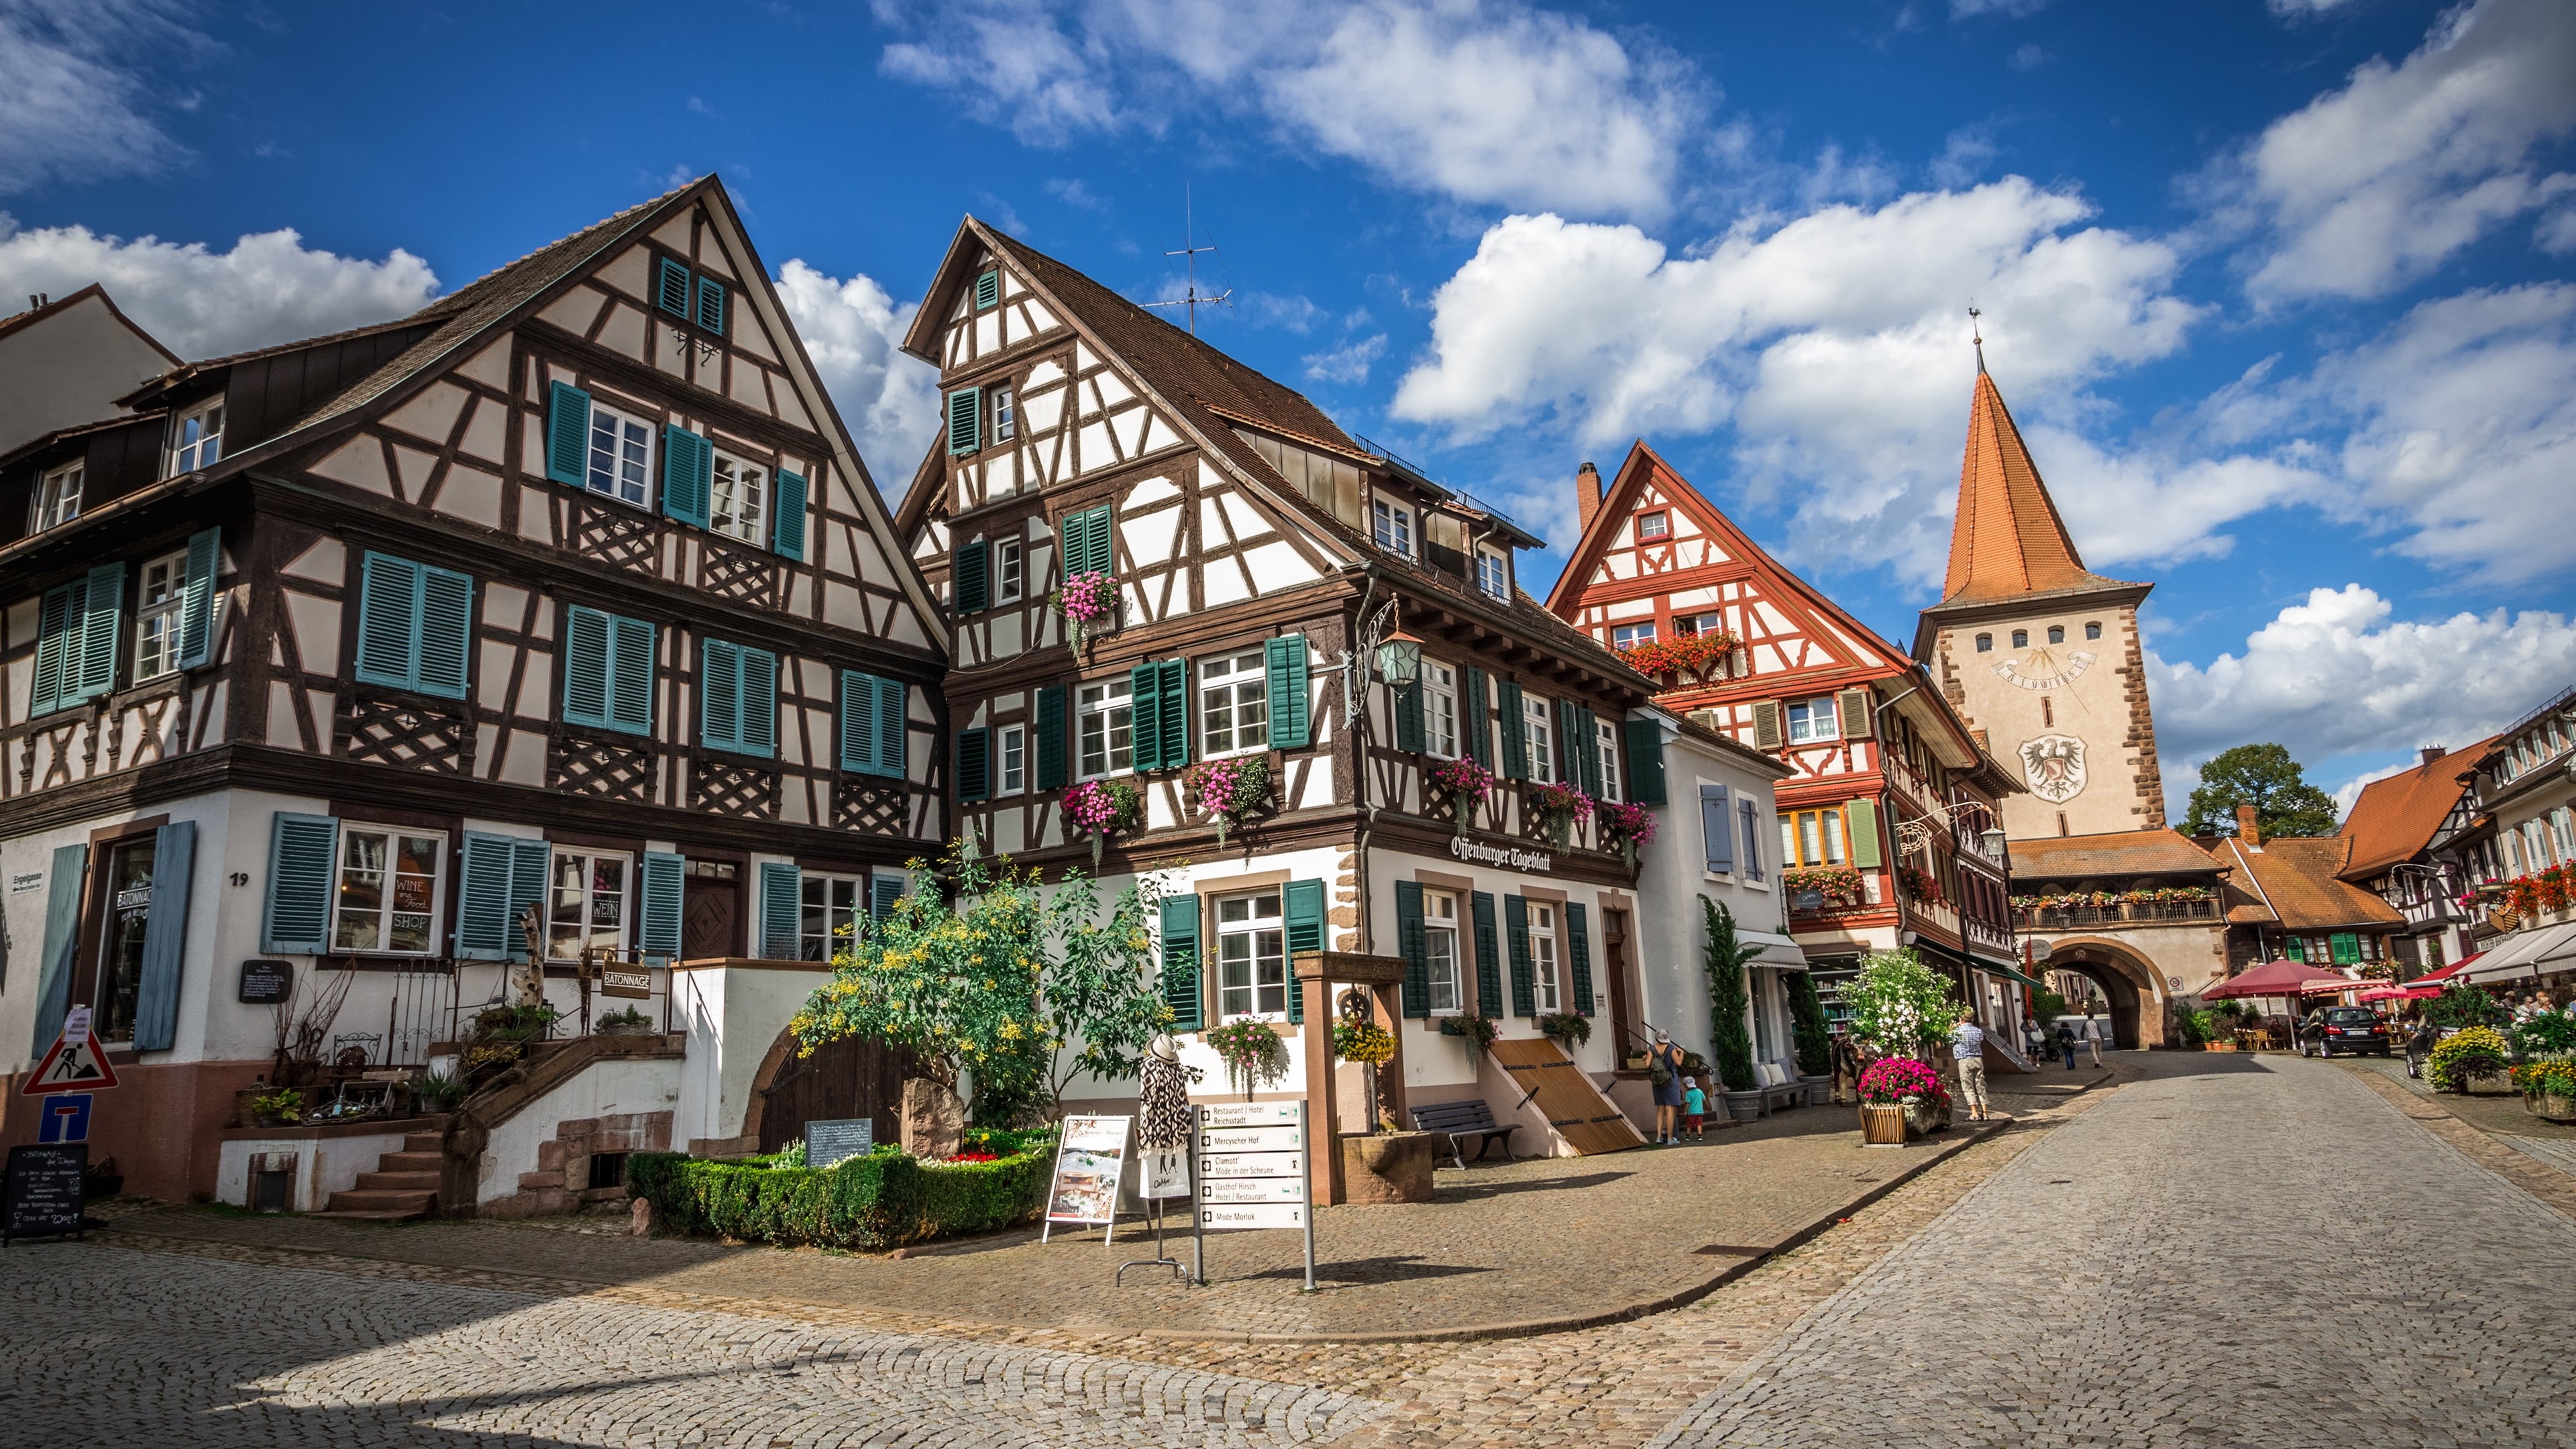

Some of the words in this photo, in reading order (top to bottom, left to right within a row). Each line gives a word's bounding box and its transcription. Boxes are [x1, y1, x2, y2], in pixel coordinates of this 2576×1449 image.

[1451, 836, 1509, 867] Offenburger
[1511, 847, 1550, 871] Tageblatt
[13, 873, 42, 885] Engelgasse
[229, 872, 249, 886] 19
[396, 879, 424, 892] WINE
[404, 897, 429, 909] Food
[592, 902, 619, 916] WEIN
[394, 915, 427, 929] SHOP
[604, 971, 650, 987] BÂTONNAGE
[1213, 1107, 1244, 1115] Restaurant
[1244, 1106, 1248, 1114] /
[1248, 1106, 1264, 1114] Hotel
[1214, 1117, 1246, 1125] Reichsstadt
[1214, 1138, 1246, 1146] Mercyscher
[1248, 1136, 1259, 1144] Hof
[1215, 1183, 1237, 1191] Gasthof
[1238, 1183, 1256, 1191] Hirsch
[1236, 1193, 1267, 1201] Restaurant
[1216, 1213, 1232, 1221] Mode
[1234, 1213, 1254, 1221] Morlok
